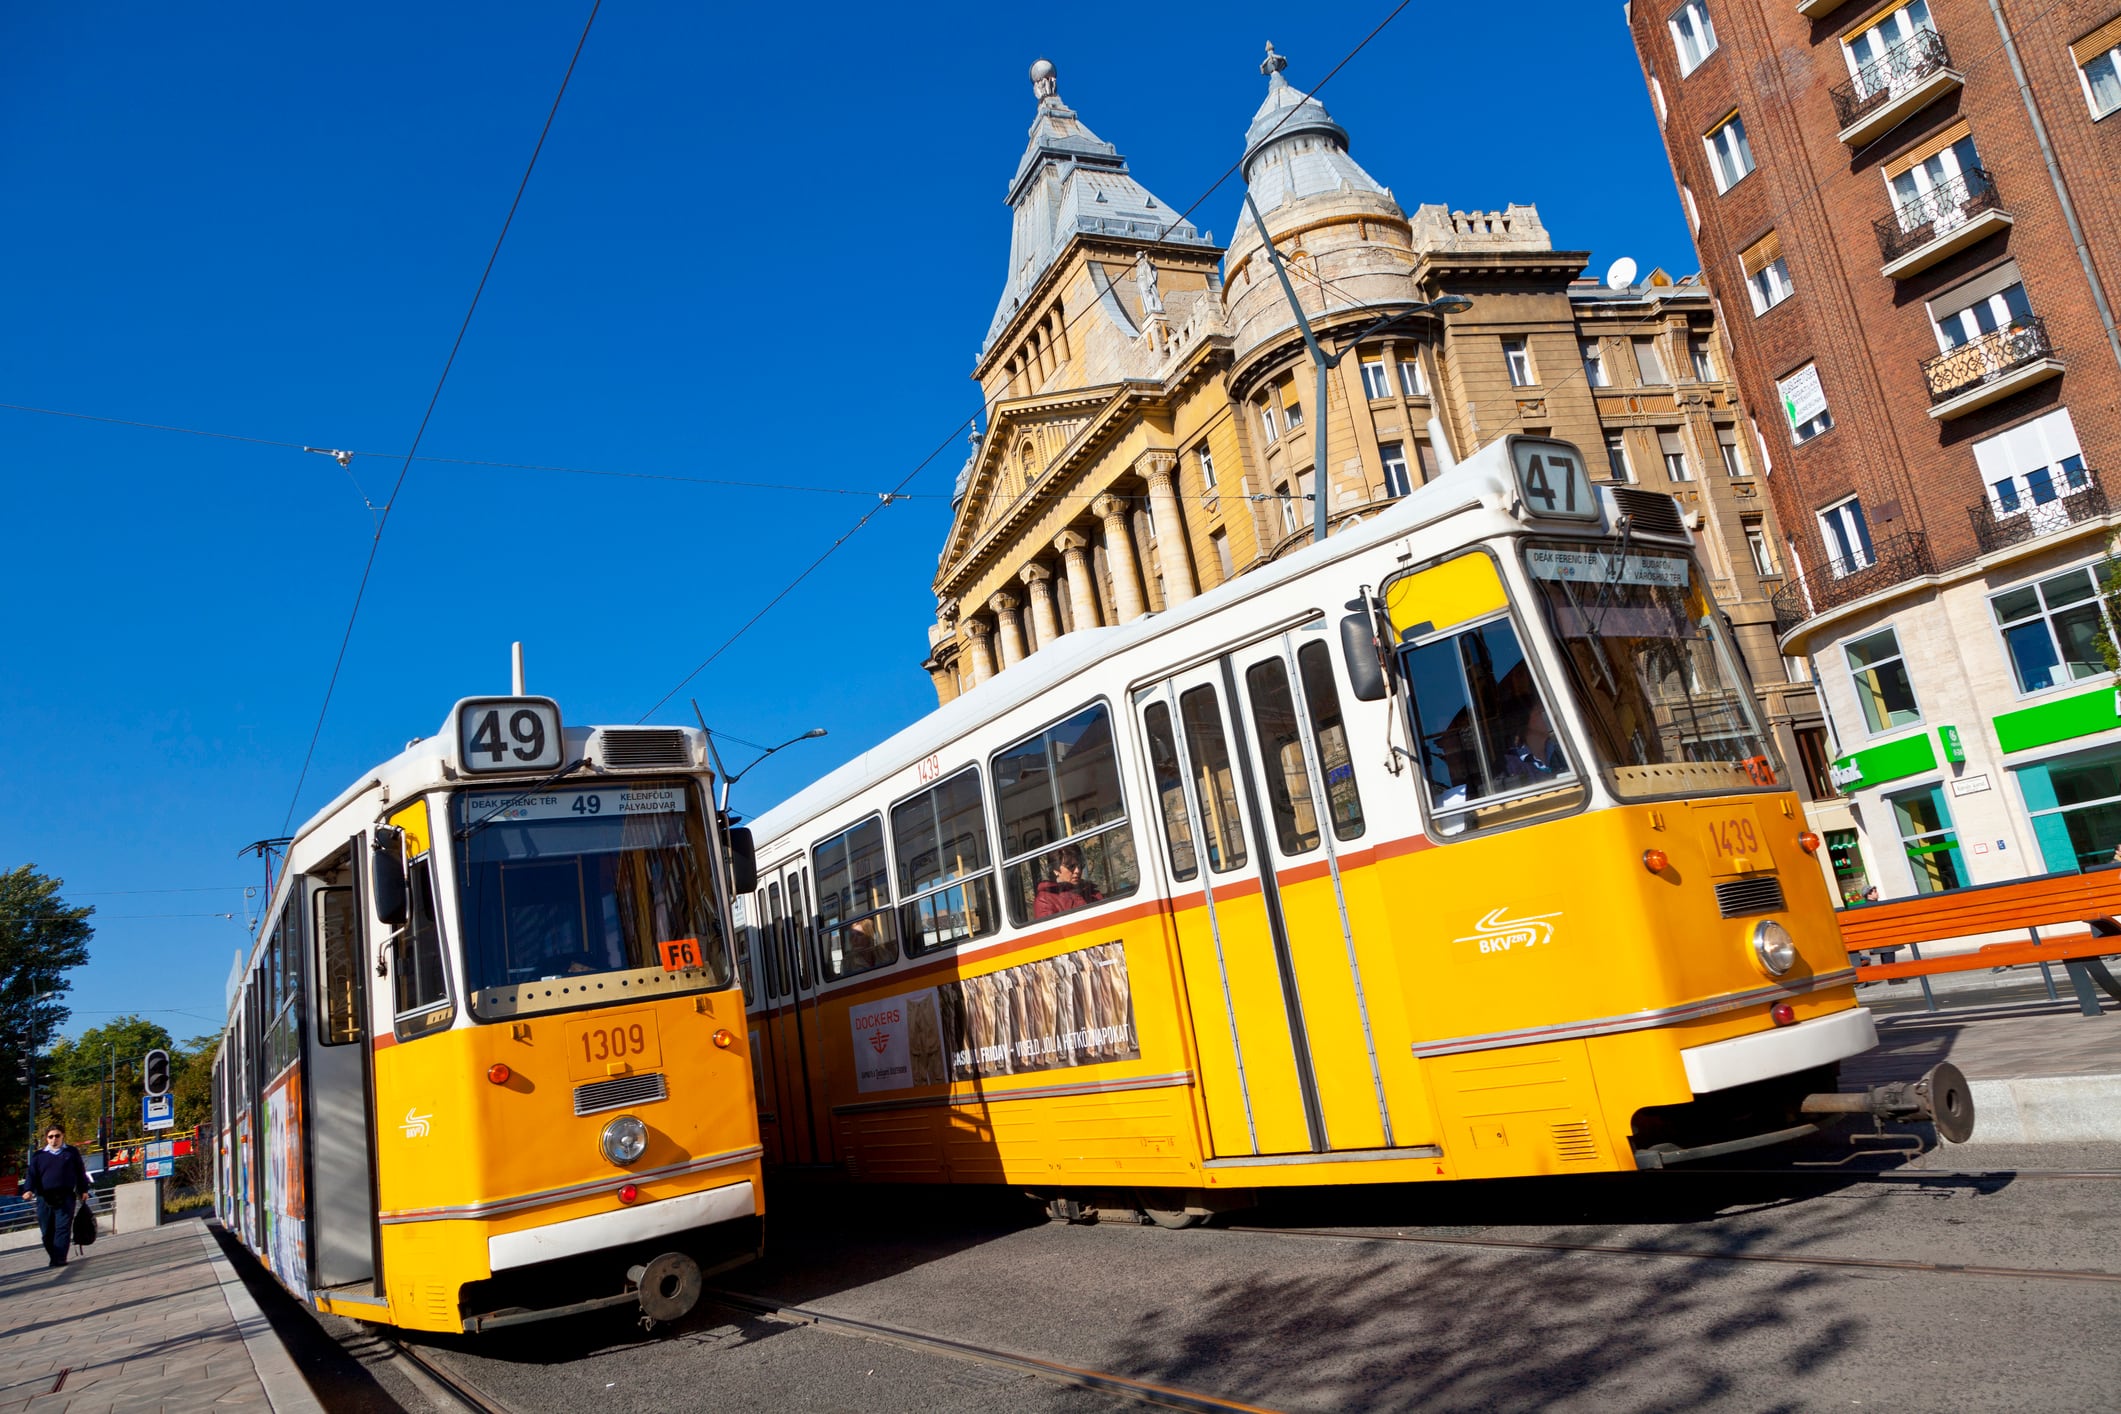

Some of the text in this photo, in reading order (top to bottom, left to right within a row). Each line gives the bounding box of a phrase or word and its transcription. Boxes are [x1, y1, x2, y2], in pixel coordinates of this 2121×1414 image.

[1526, 454, 1576, 512] 47
[1533, 551, 1553, 562] DEÁK
[1555, 554, 1582, 564] FERENC
[469, 709, 545, 762] 49
[917, 755, 939, 785] 1439
[471, 795, 558, 809] DEÁK FERENC TÉR
[571, 795, 601, 814] 49
[618, 801, 676, 812] PÁLYAUDVAR
[620, 791, 673, 801] KELENFÖLDI
[1708, 818, 1759, 858] 1439
[668, 943, 694, 966] F6
[1479, 936, 1511, 954] BKV
[855, 1009, 900, 1031] DOCKERS
[581, 1023, 645, 1063] 1309
[953, 1048, 980, 1066] CASUL
[981, 1043, 1008, 1063] FRIDAY
[1015, 1038, 1040, 1057] VISELD
[1041, 1033, 1056, 1053] JÓL
[1056, 1035, 1063, 1052] A
